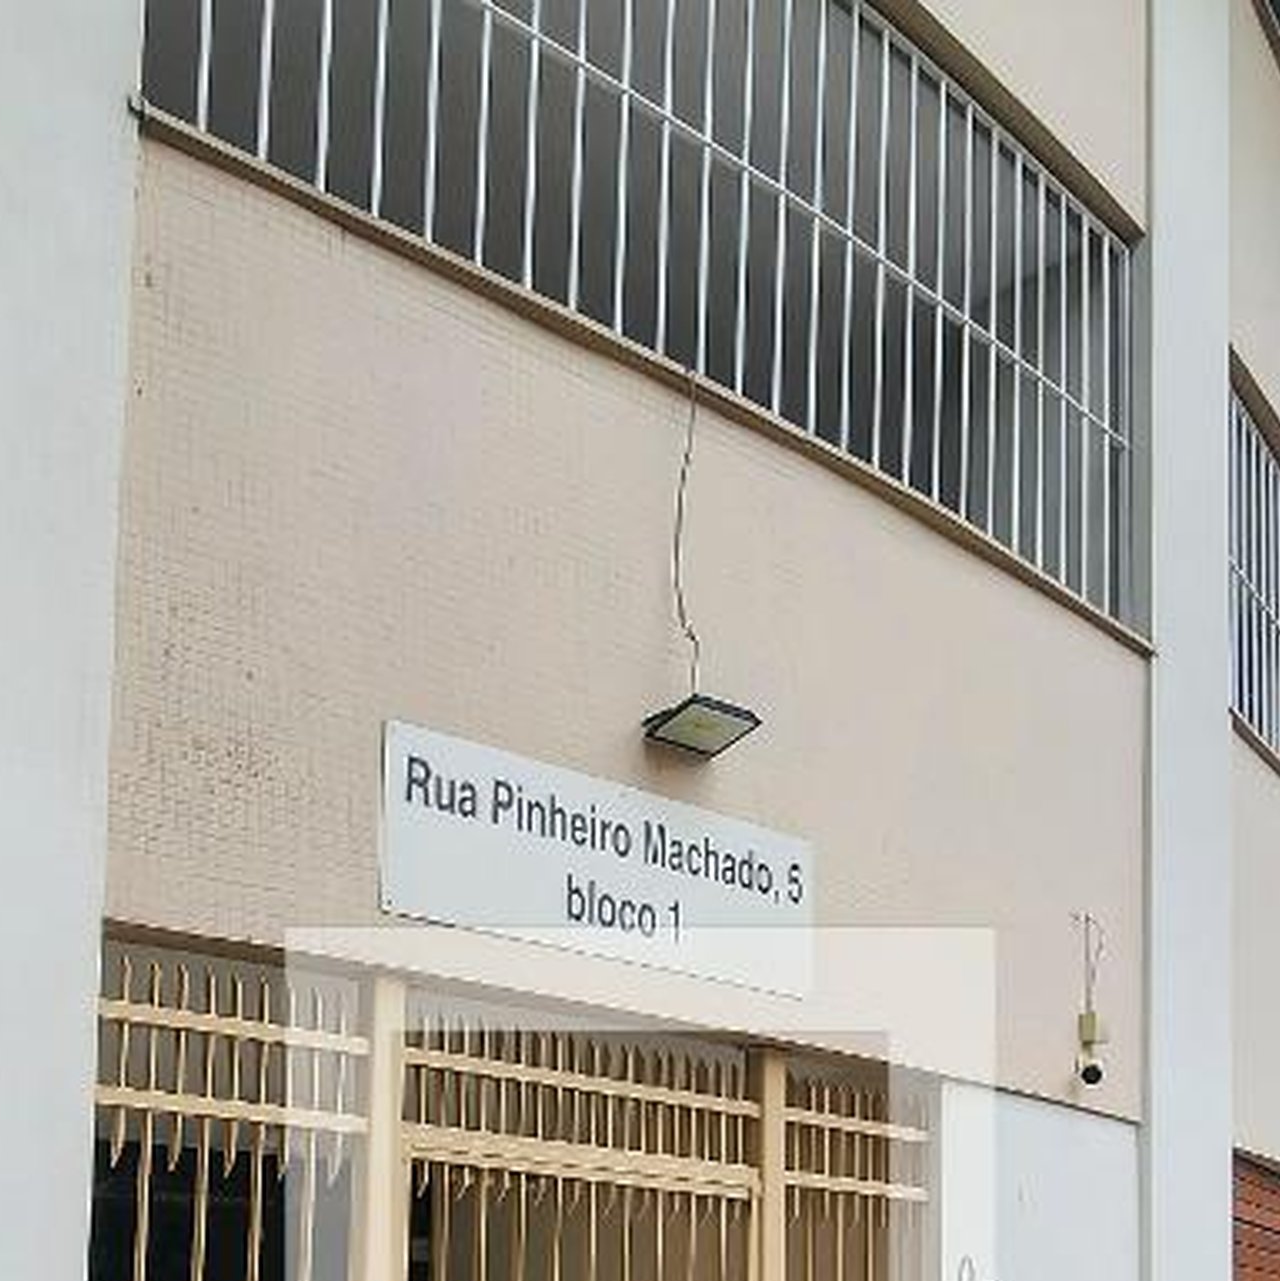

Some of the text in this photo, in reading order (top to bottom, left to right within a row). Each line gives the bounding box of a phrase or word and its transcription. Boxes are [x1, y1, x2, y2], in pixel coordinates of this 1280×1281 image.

[405, 755, 803, 904] Rua Pinheiro Machado, 5
[566, 873, 683, 944] bloco 1
